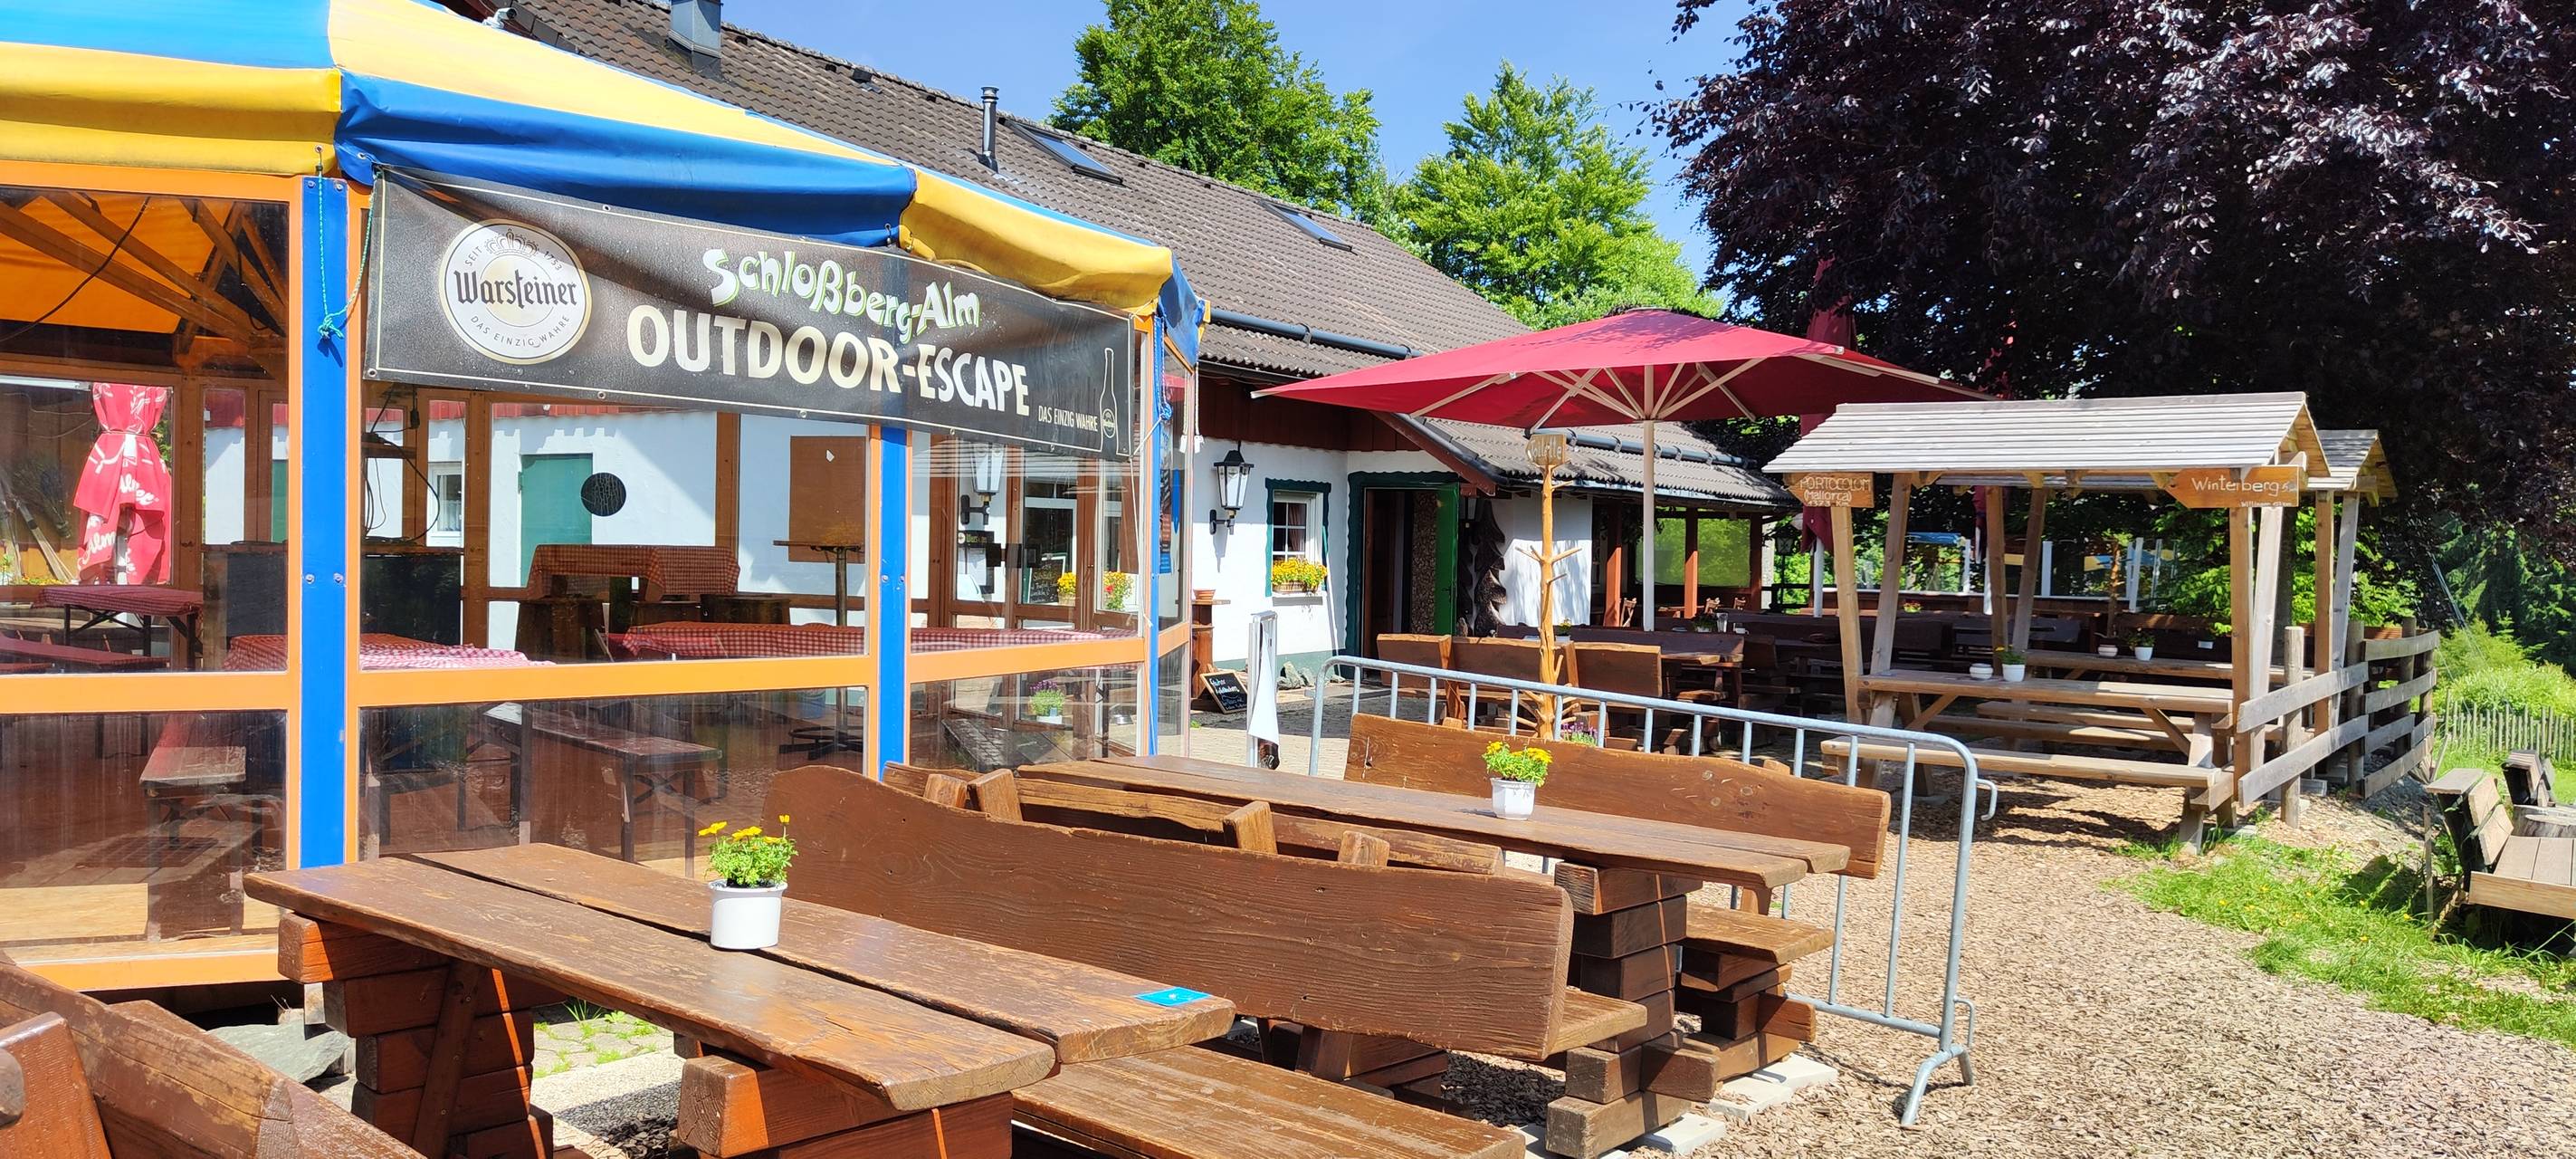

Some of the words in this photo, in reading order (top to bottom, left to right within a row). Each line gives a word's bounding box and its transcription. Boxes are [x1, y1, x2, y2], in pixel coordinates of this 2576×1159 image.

[464, 245, 482, 267] SEIT
[543, 250, 563, 271] 1753
[453, 269, 577, 310] Warsteiner
[702, 248, 980, 343] Schloßberg-Alm
[470, 315, 491, 335] DAS
[493, 333, 536, 348] EINZIG
[539, 315, 570, 343] WAHRE
[626, 304, 1030, 417] OUTDOOR-ESCAPE
[1038, 405, 1053, 424] DAS
[1054, 407, 1074, 428] EINZIG
[1075, 412, 1098, 432] WAHRE
[1799, 476, 1871, 492] PORTOCOLOM
[1803, 489, 1853, 503] (Mallorca)
[2190, 474, 2280, 497] Winterberg
